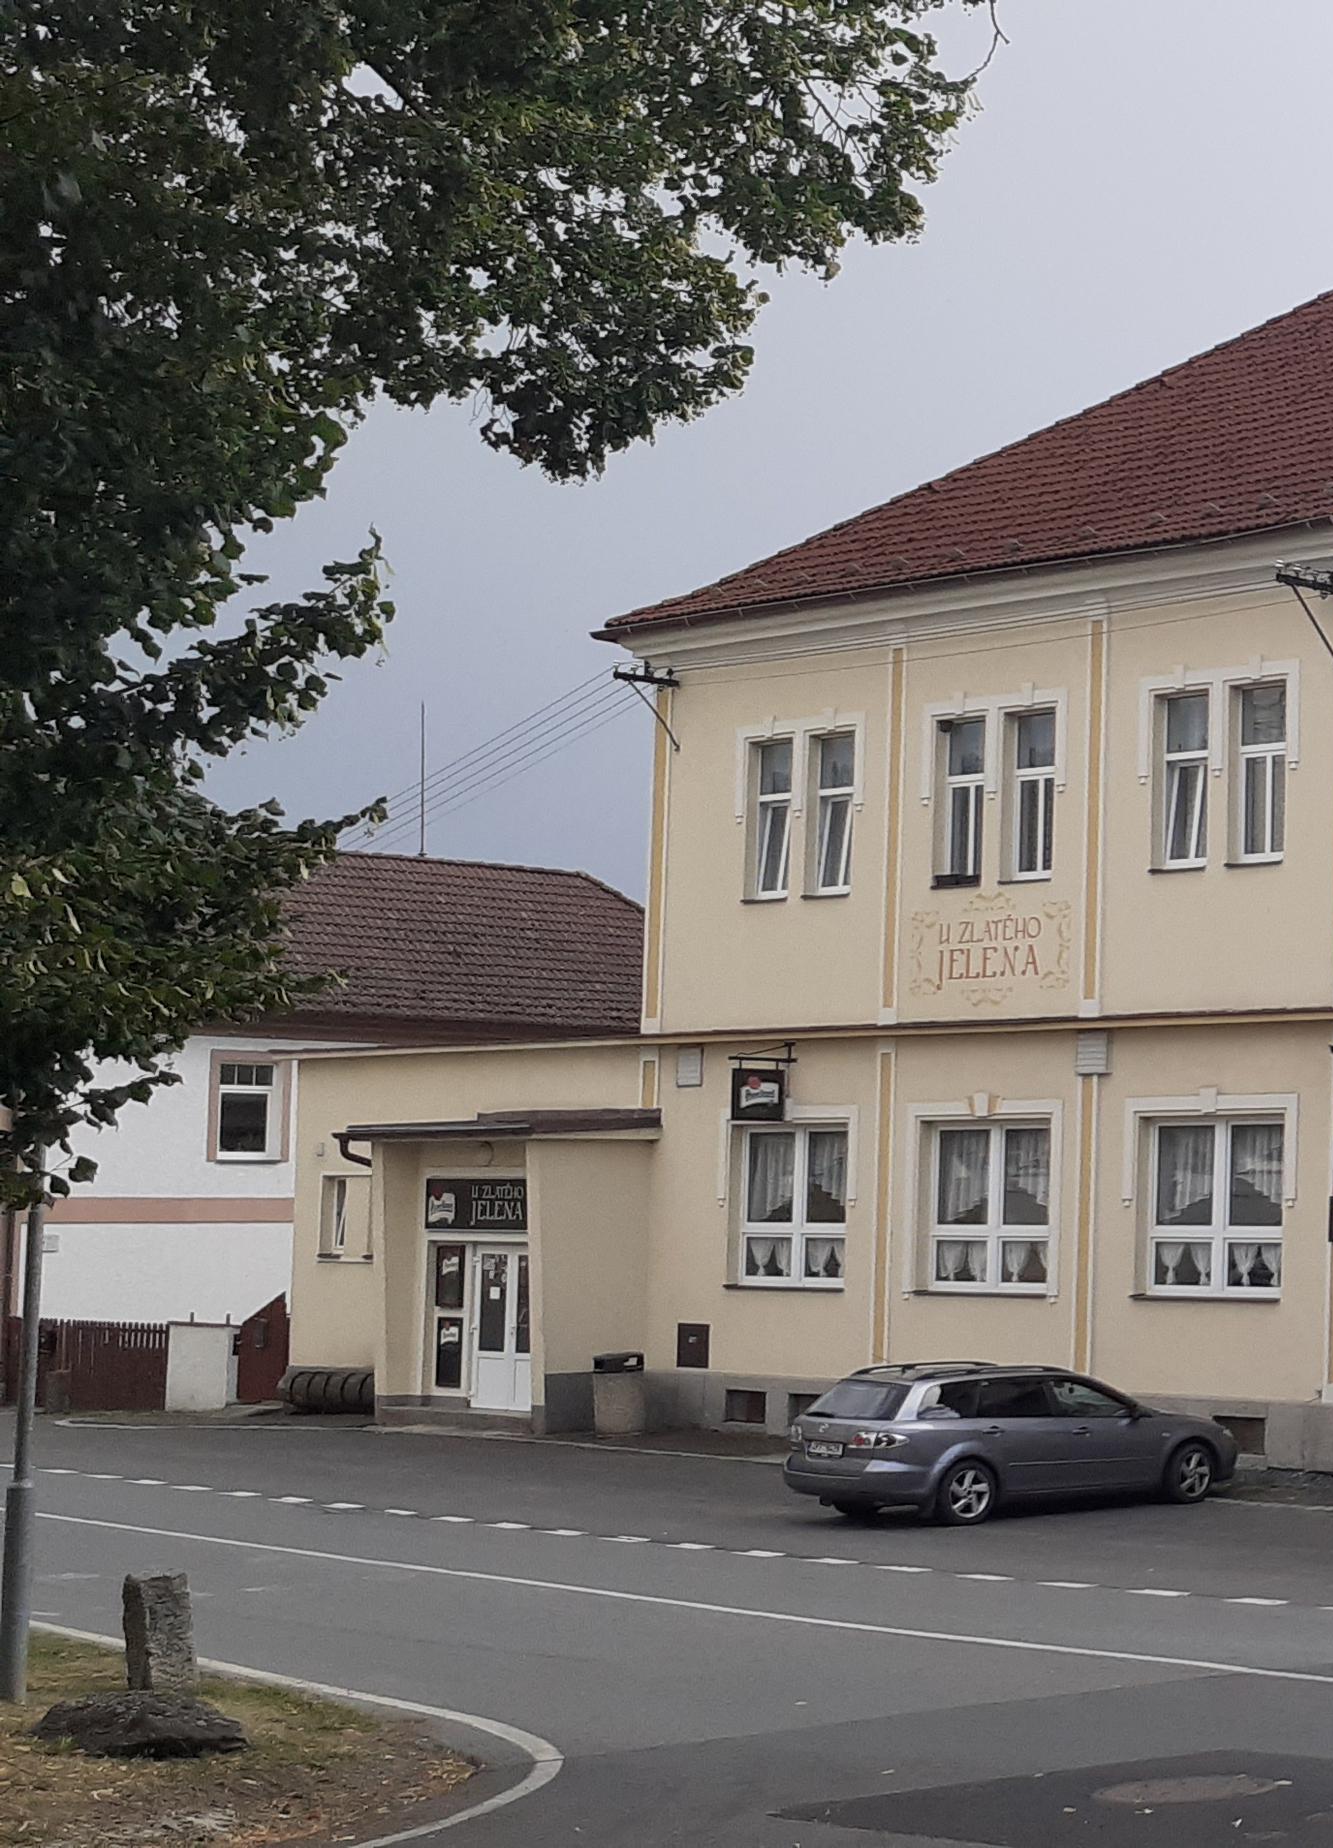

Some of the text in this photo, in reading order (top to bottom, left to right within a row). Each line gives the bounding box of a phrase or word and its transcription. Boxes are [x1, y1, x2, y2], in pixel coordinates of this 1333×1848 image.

[939, 914, 1042, 944] U ZLATÉHO
[936, 944, 1040, 991] JELENA
[471, 1182, 524, 1199] U ZLATÉHO
[470, 1200, 523, 1226] JELENA
